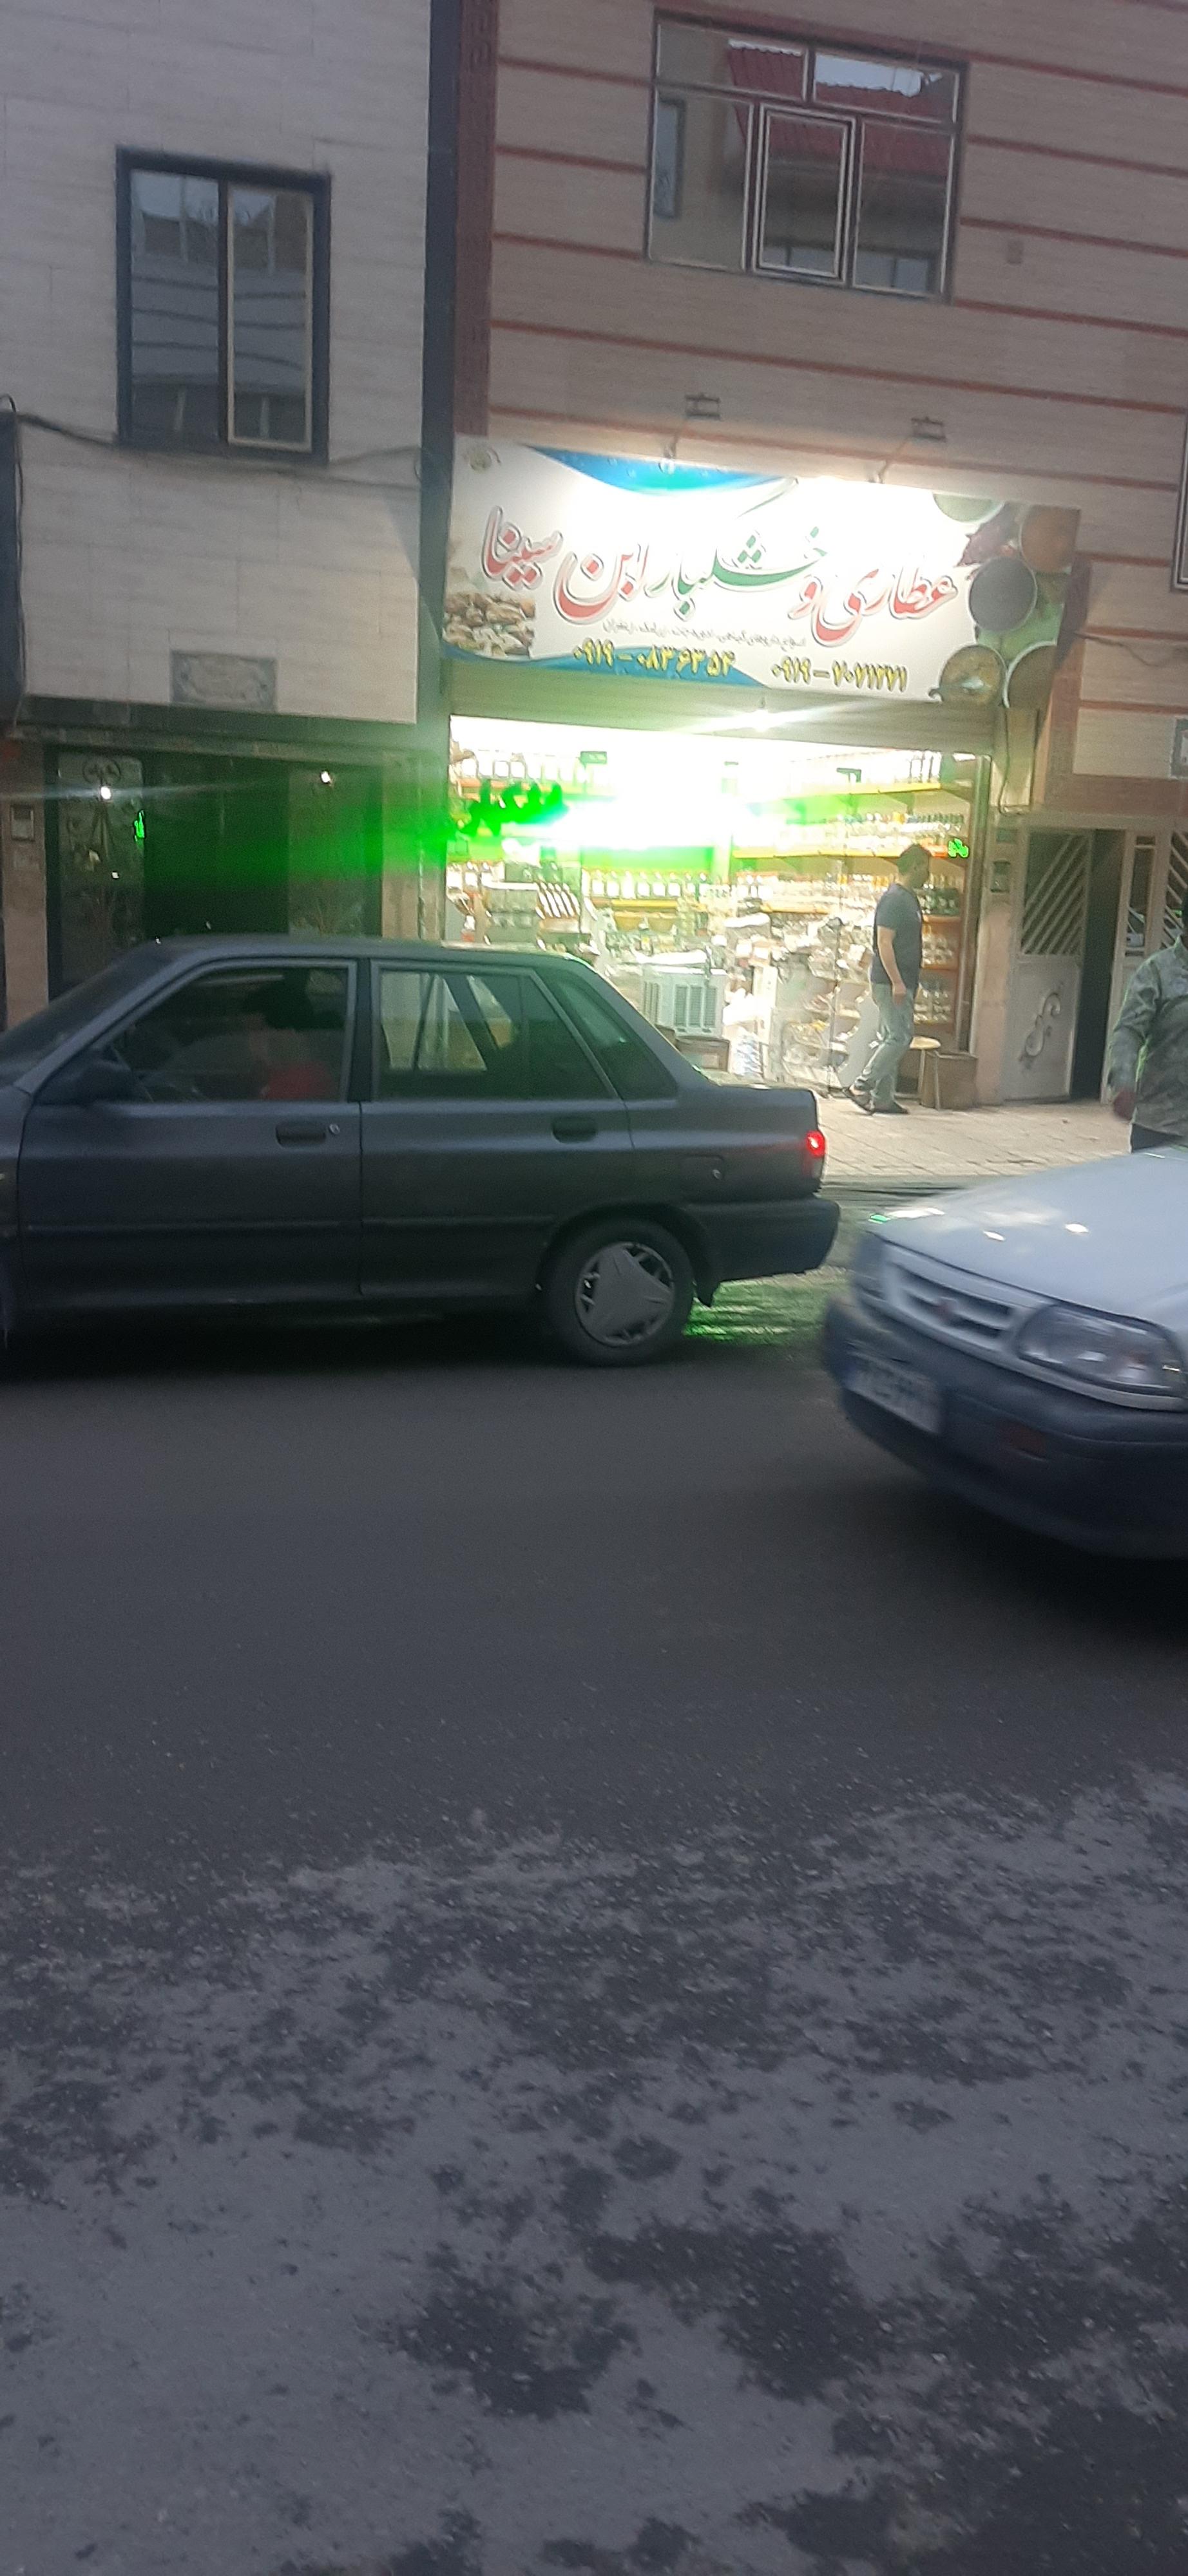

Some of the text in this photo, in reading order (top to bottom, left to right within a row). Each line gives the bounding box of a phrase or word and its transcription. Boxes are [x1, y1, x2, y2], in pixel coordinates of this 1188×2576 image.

[481, 506, 563, 591] سینا
[553, 543, 650, 625] ابن
[643, 478, 828, 621] خشکبار
[787, 576, 823, 620] و
[810, 559, 958, 647] عطاری
